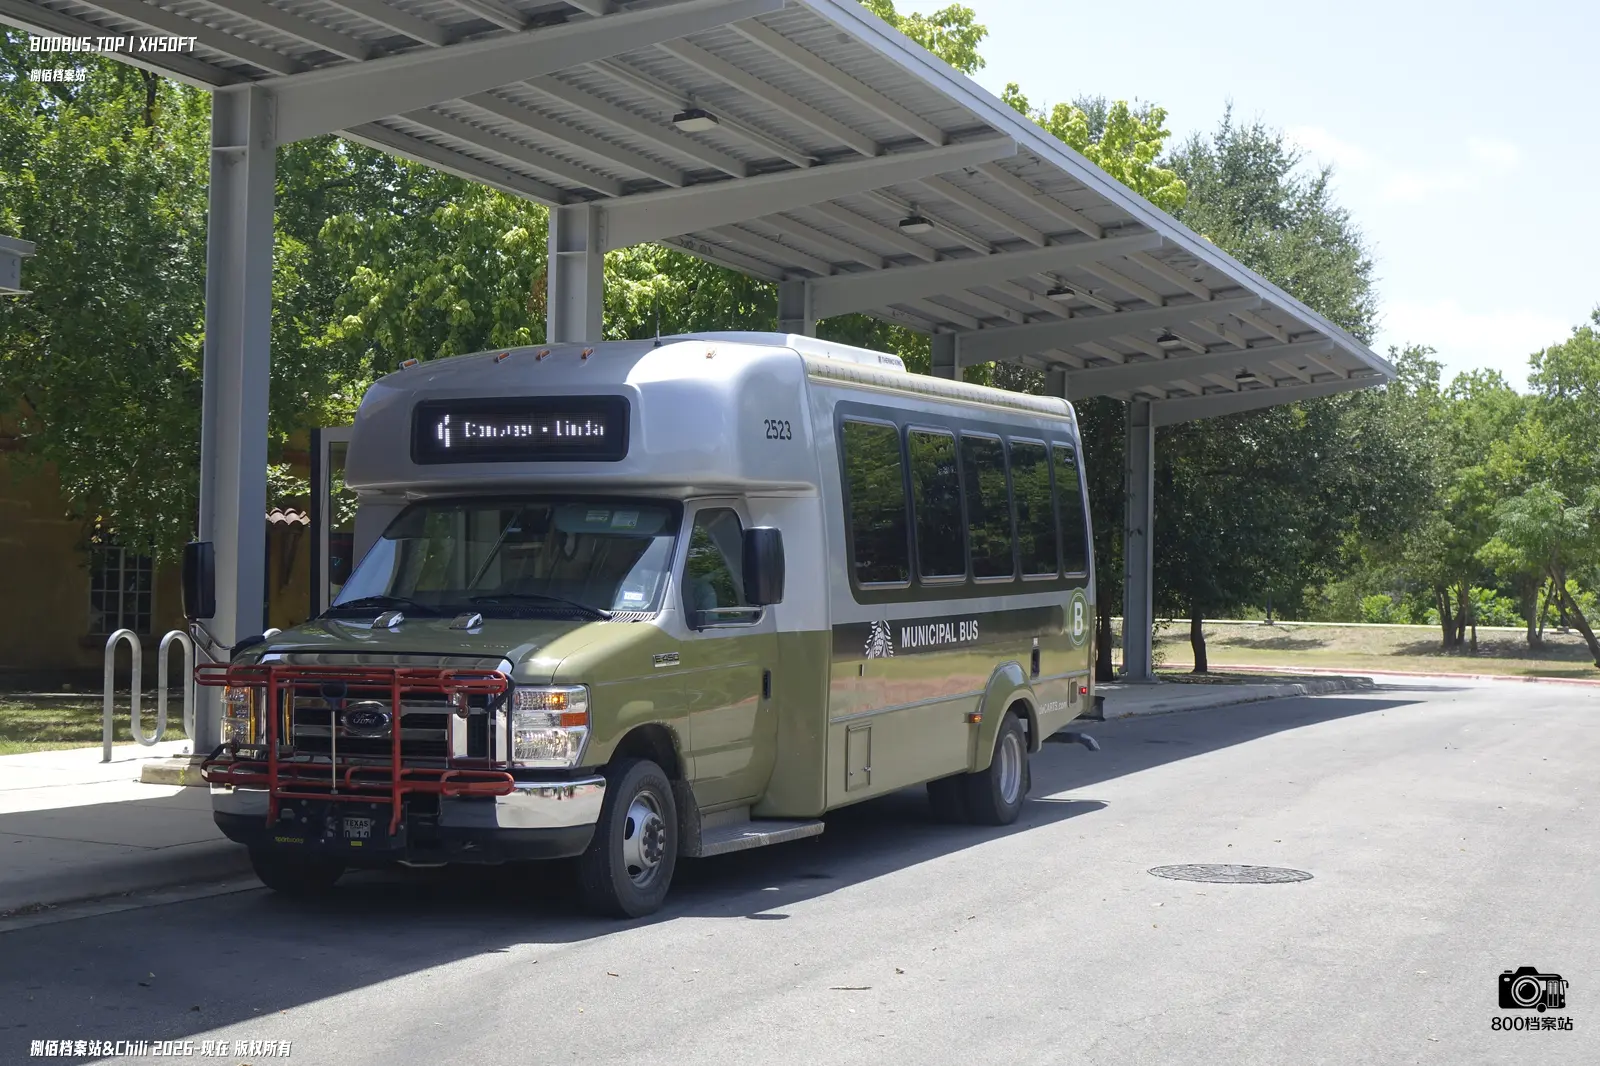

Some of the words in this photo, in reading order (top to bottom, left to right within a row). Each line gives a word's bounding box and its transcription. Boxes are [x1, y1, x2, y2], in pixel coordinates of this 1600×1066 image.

[764, 419, 792, 440] 2523
[1074, 602, 1083, 635] B
[901, 622, 957, 648] MUNICIPAL
[959, 620, 979, 642] BUS
[353, 713, 377, 725] Ford
[345, 819, 369, 828] TEXAS
